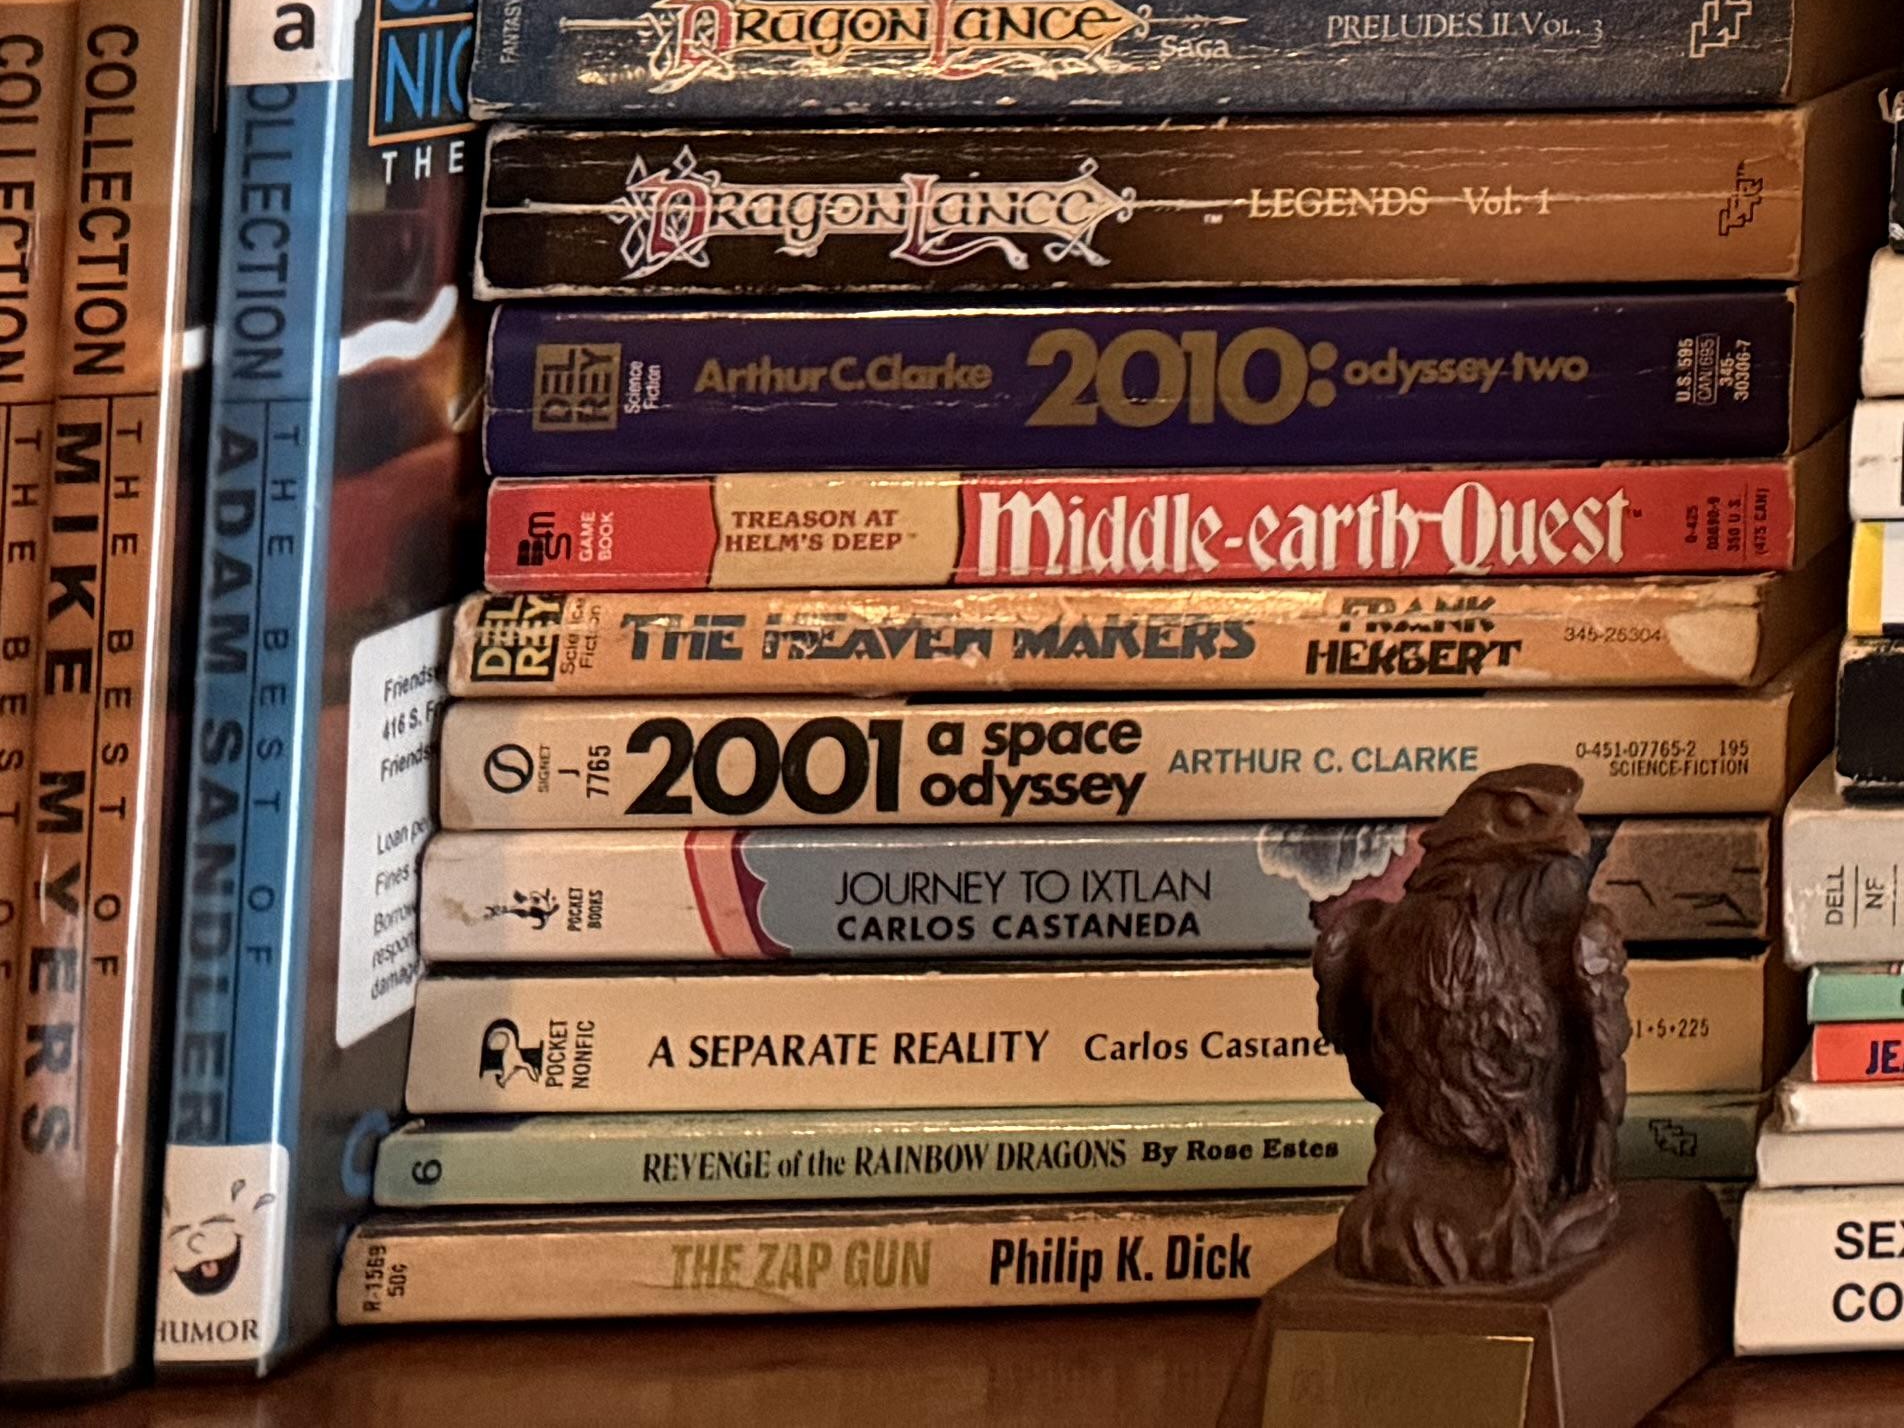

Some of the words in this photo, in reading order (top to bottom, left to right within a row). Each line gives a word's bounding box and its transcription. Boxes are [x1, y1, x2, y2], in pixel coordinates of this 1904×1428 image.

[72, 23, 140, 378] COLLECTION
[624, 360, 643, 414] Science
[644, 364, 661, 409] Fiction
[725, 532, 824, 553] HELM'S
[832, 531, 902, 552] DEEP
[731, 509, 842, 530] TREASON
[862, 509, 898, 528] AT
[45, 421, 102, 696] MIKE
[624, 716, 900, 815] 2001
[926, 723, 967, 757] a
[981, 719, 1143, 766] space
[1169, 748, 1300, 775] ARTHUR
[1314, 748, 1343, 774] C.
[1352, 745, 1479, 772] CLARKE
[1575, 741, 1698, 760] 0-451-07765-2
[1720, 739, 1749, 758] 195
[1609, 757, 1749, 777] SCIENCE-FICTION
[920, 759, 1147, 817] odyssey
[1825, 865, 1845, 926] DELL
[20, 768, 87, 1156] MYERS
[546, 1019, 567, 1088] POCKET
[573, 1020, 596, 1088] NONFIC
[990, 1236, 1103, 1293] Philip
[1116, 1235, 1152, 1282] K.
[1166, 1232, 1250, 1281] Dick
